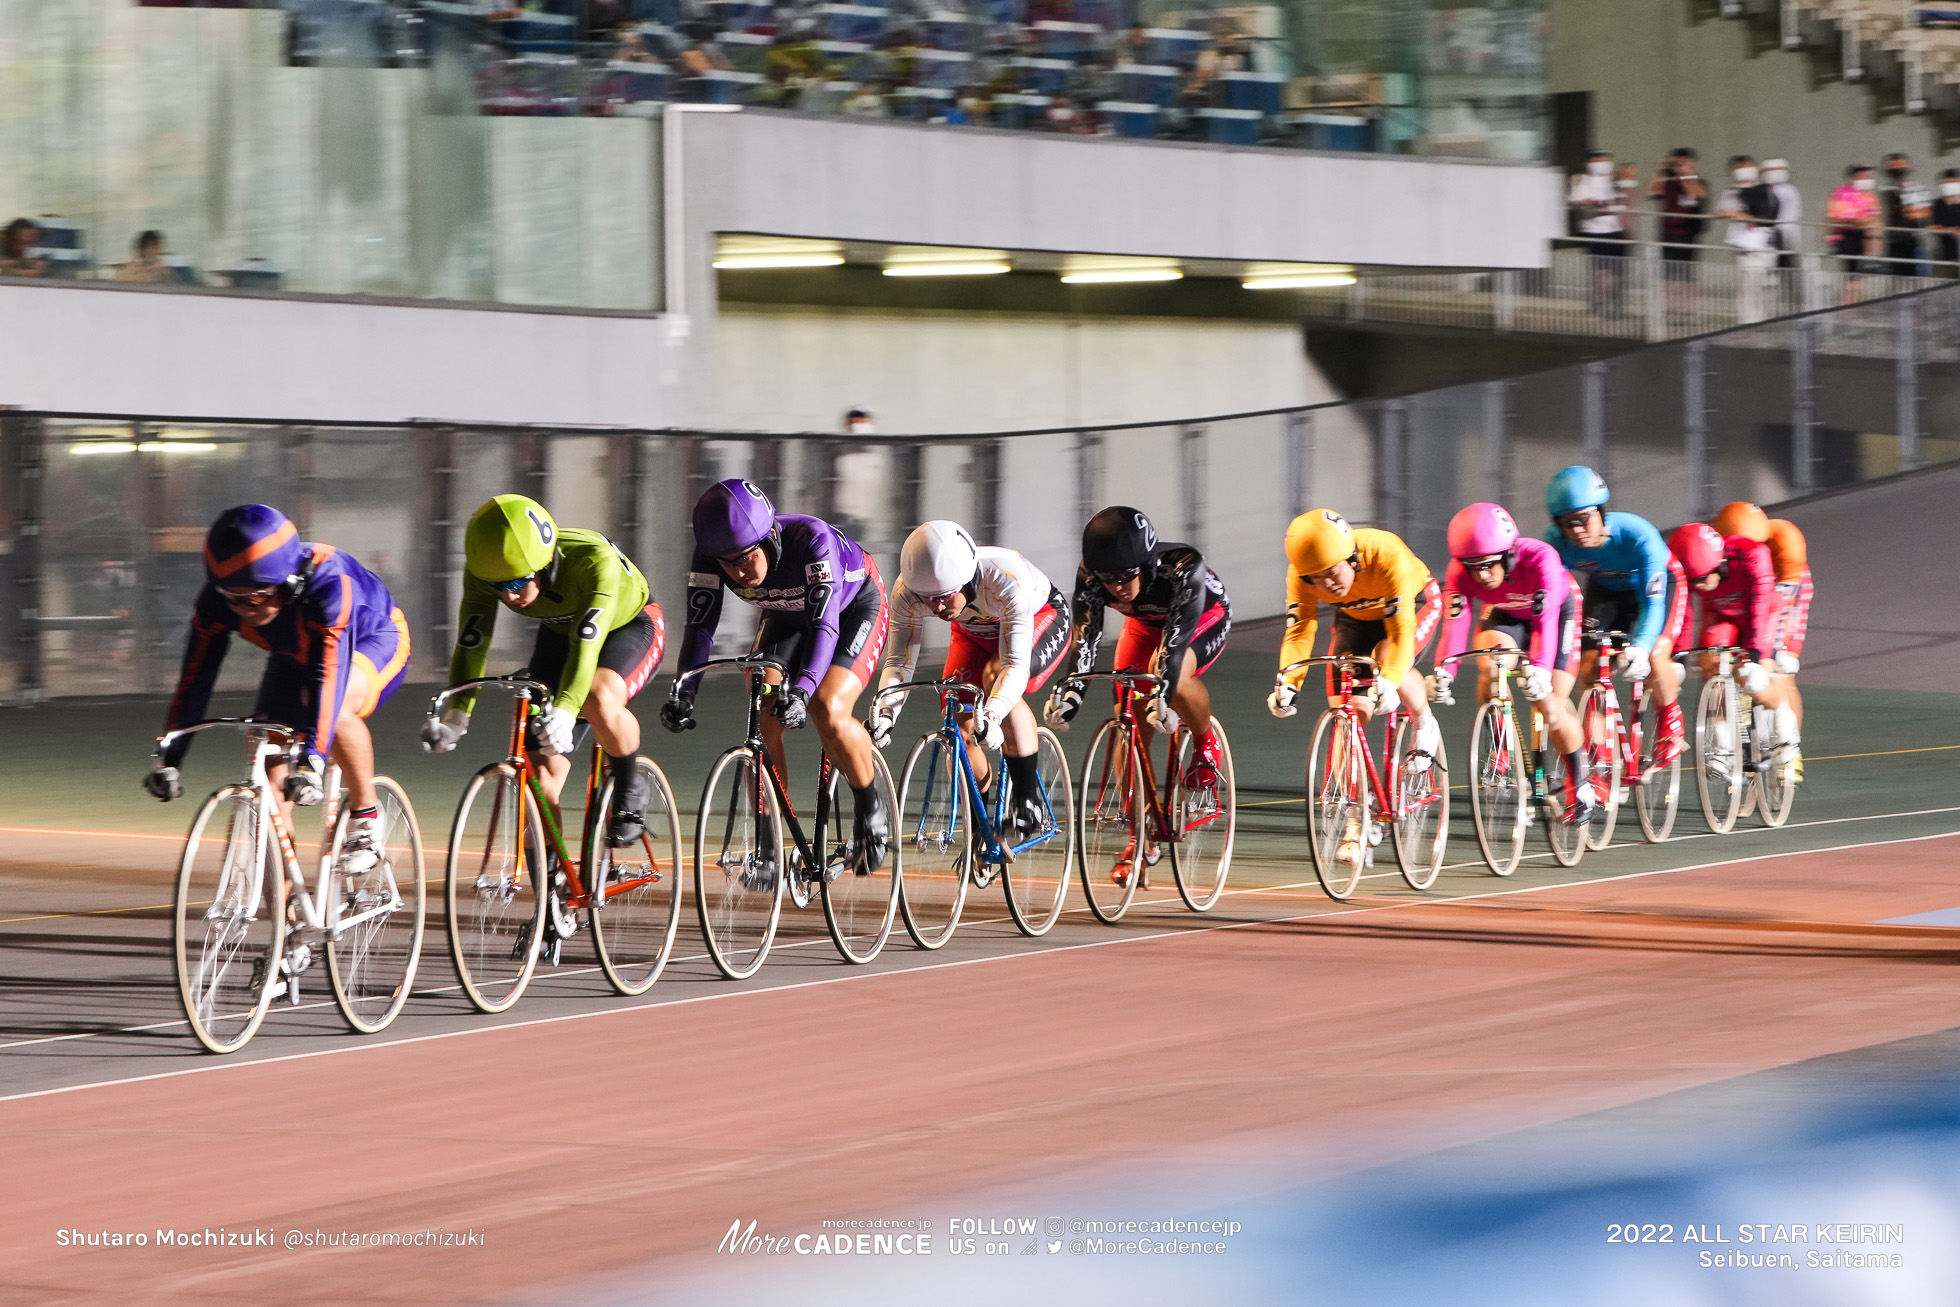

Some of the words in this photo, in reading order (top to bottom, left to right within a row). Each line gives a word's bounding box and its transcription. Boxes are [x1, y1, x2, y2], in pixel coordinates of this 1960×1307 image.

[741, 480, 773, 516] 9
[525, 506, 556, 547] 6
[956, 529, 977, 560] 1
[1134, 512, 1159, 552] 2
[690, 589, 716, 625] 9
[808, 583, 834, 622] 9
[458, 613, 484, 648] 6
[577, 607, 605, 642] 6
